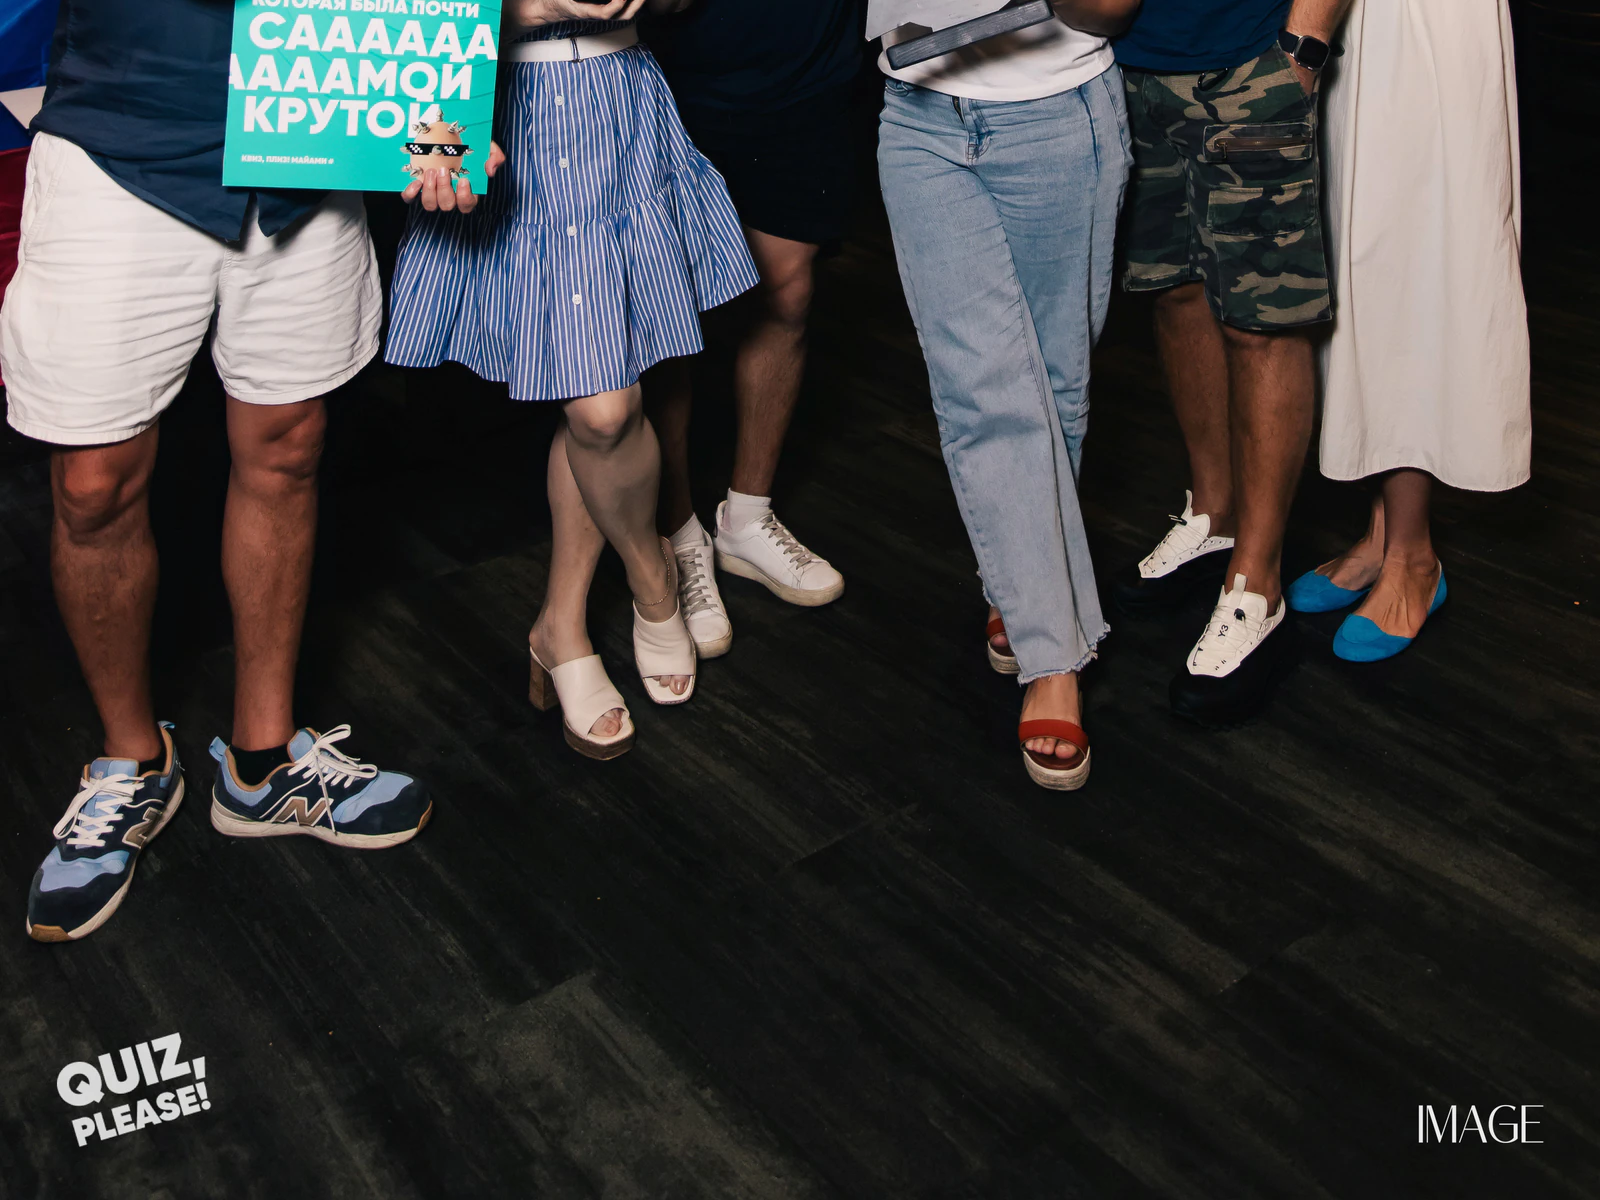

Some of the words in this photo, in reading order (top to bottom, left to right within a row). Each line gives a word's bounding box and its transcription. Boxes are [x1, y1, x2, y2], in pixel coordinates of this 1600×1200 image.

[412, 0, 479, 19] ПОЧТИ
[249, 11, 498, 60] САААААА
[241, 154, 265, 163] КВИЗ,
